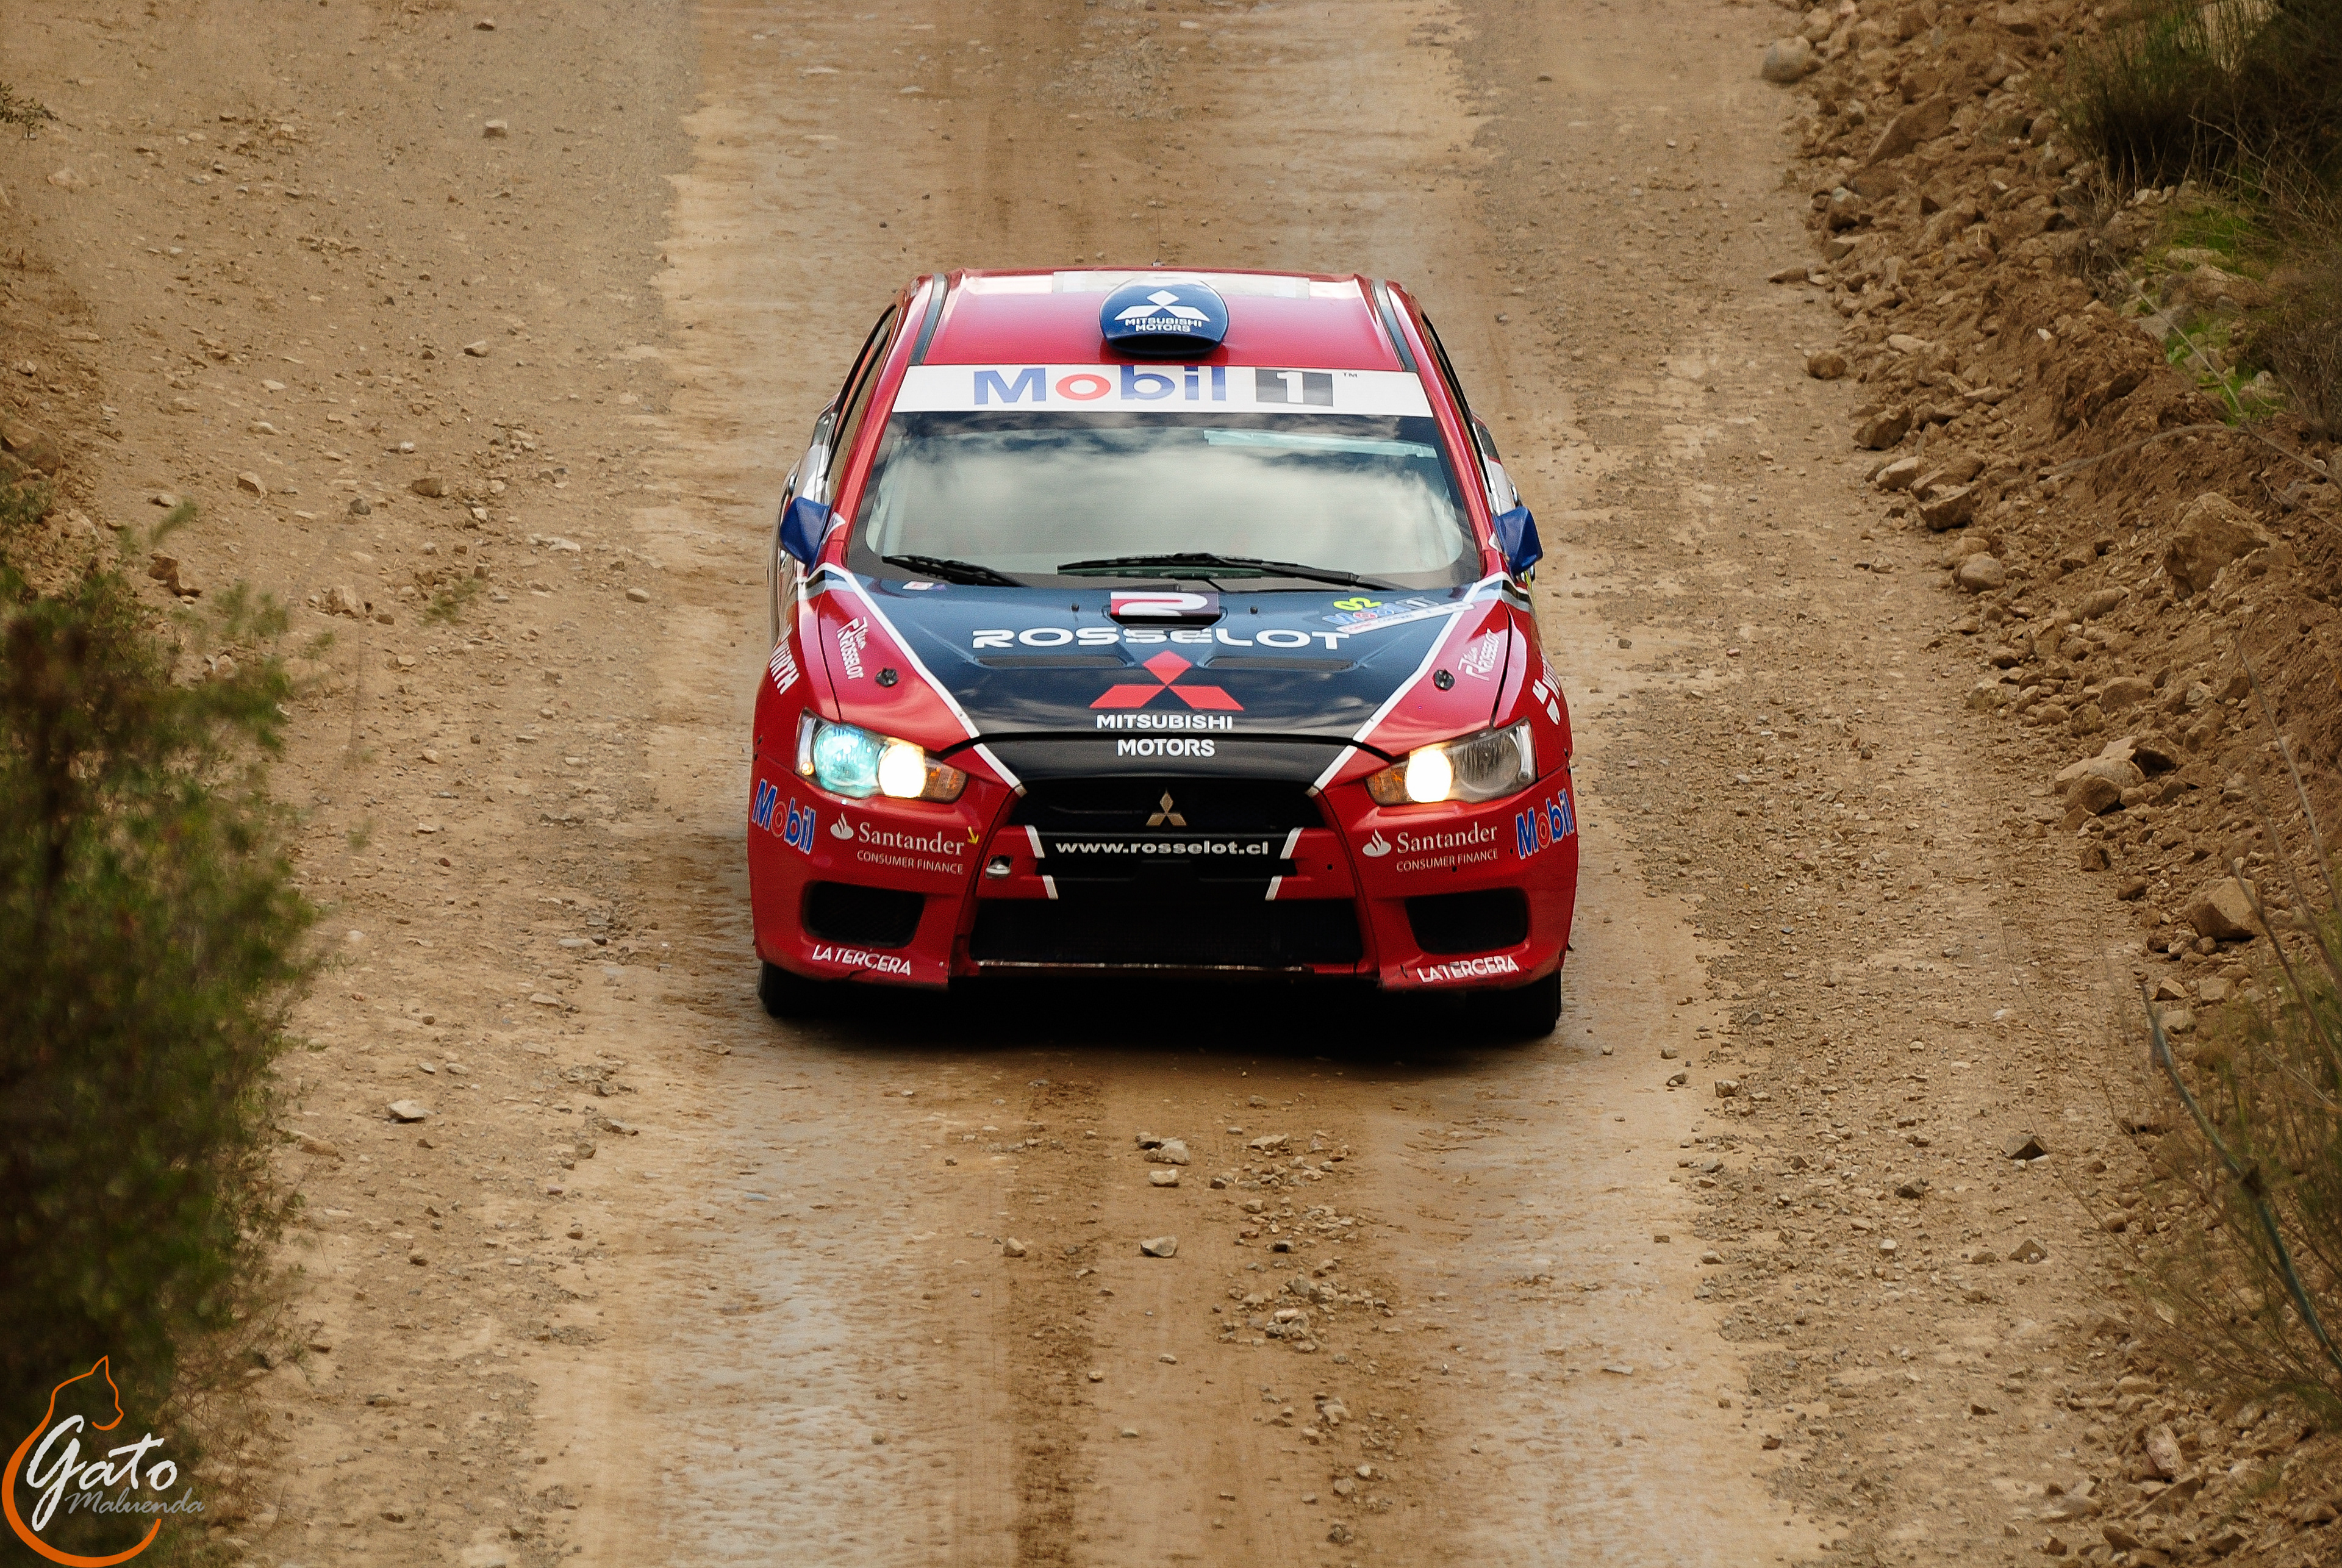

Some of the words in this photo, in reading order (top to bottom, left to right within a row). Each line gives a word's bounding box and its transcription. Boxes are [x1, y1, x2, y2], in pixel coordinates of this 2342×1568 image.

[1125, 317, 1203, 328] MITSUBISHI
[1135, 324, 1191, 332] MOTORS
[973, 365, 1227, 406] Mobil
[972, 627, 1350, 651] ROSSELOT
[1097, 714, 1233, 730] MITSUBISHI
[1117, 739, 1216, 758] MOTORS
[751, 778, 817, 855] Mobil
[1515, 788, 1574, 860] Mobil
[858, 821, 965, 856] Santander
[1056, 840, 1268, 854] www.rosselot.cl
[1396, 822, 1498, 854] Santander
[857, 850, 915, 869] CONSUMER
[917, 858, 964, 875] FINANCE
[1396, 854, 1455, 873] CONSUMER
[1457, 848, 1499, 865] FINANCE
[834, 947, 912, 976] TERCERA
